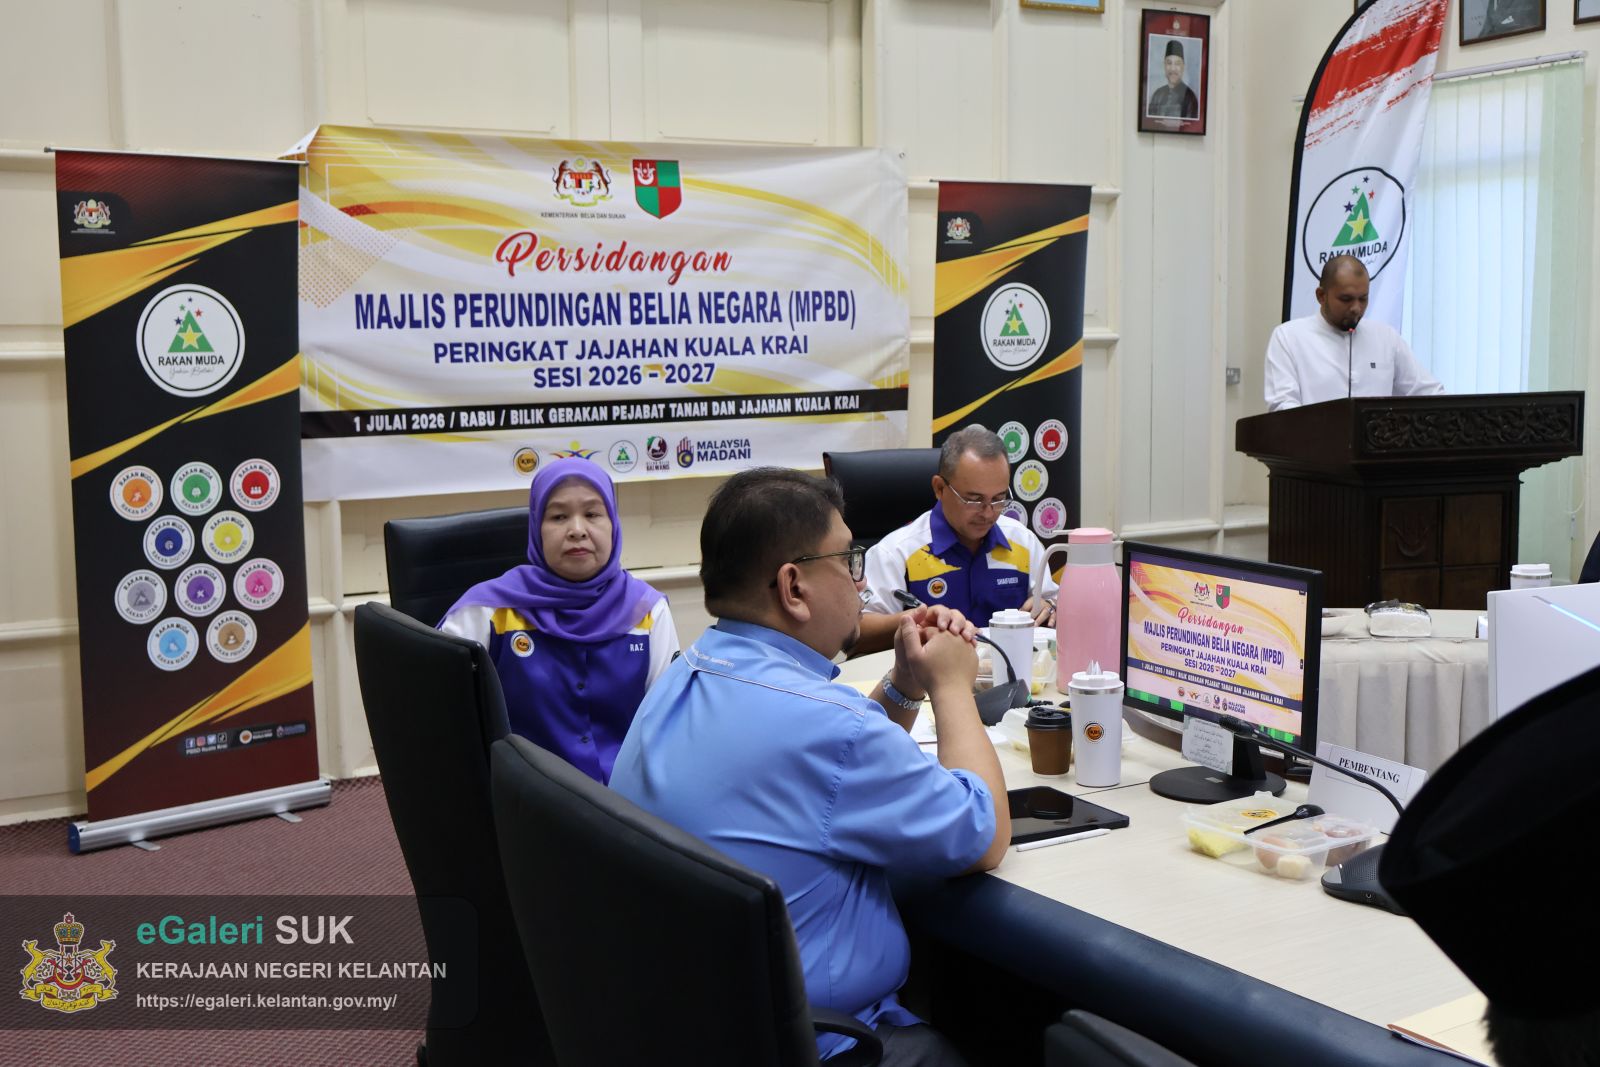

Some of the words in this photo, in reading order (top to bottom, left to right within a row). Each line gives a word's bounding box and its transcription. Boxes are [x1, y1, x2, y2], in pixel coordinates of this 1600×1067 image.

[495, 231, 733, 286] Persidangan
[1358, 240, 1388, 258] MUDA
[354, 292, 446, 330] MAJLIS
[454, 292, 622, 329] PERUNDINGAN
[629, 291, 692, 326] BELIA
[698, 290, 783, 325] NEGARA
[788, 290, 856, 332] (MPBD)
[434, 340, 569, 364] PERINGKAT
[576, 338, 678, 360] JAJAHAN
[684, 336, 756, 358] KUALA
[761, 334, 808, 354] KRAI
[993, 338, 1016, 348] RAKAN
[1016, 338, 1036, 346] MUDA
[158, 356, 193, 366] RAKAN
[195, 356, 225, 365] MUDA
[533, 367, 582, 389] SESI
[588, 365, 642, 387] 2026
[664, 362, 716, 384] 2027
[353, 416, 361, 432] 1
[366, 414, 407, 432] JULAI
[411, 413, 446, 430] 2026
[449, 411, 456, 428] /
[460, 410, 496, 428] RABU
[500, 409, 506, 426] /
[510, 408, 545, 426] BILIK
[550, 406, 608, 423] GERAKAN
[612, 403, 665, 421] PEJABAT
[669, 402, 708, 418] TANAH
[712, 400, 736, 416] DAN
[740, 398, 792, 415] JAJAHAN
[795, 396, 831, 412] KUALA
[834, 395, 860, 410] KRAI
[696, 438, 751, 451] MALAYSIA
[697, 448, 751, 462] MADANI
[1178, 606, 1245, 637] Persidangan
[630, 642, 644, 652] RAZ
[1144, 620, 1166, 638] MAJLIS
[1166, 626, 1211, 648] PERUNDINGAN
[1212, 636, 1230, 654] BELIA
[1232, 640, 1259, 660] NEGARA
[1260, 647, 1285, 670] (MPBD)
[1160, 642, 1195, 657] PERINGKAT
[1196, 650, 1226, 666] JAJAHAN
[1226, 658, 1249, 671] KUALA
[1250, 664, 1266, 676] KRAI
[1184, 658, 1198, 669] SESI
[1198, 662, 1214, 673] 2026
[1220, 667, 1236, 678] 2027
[1338, 757, 1400, 784] PEMBENTANG
